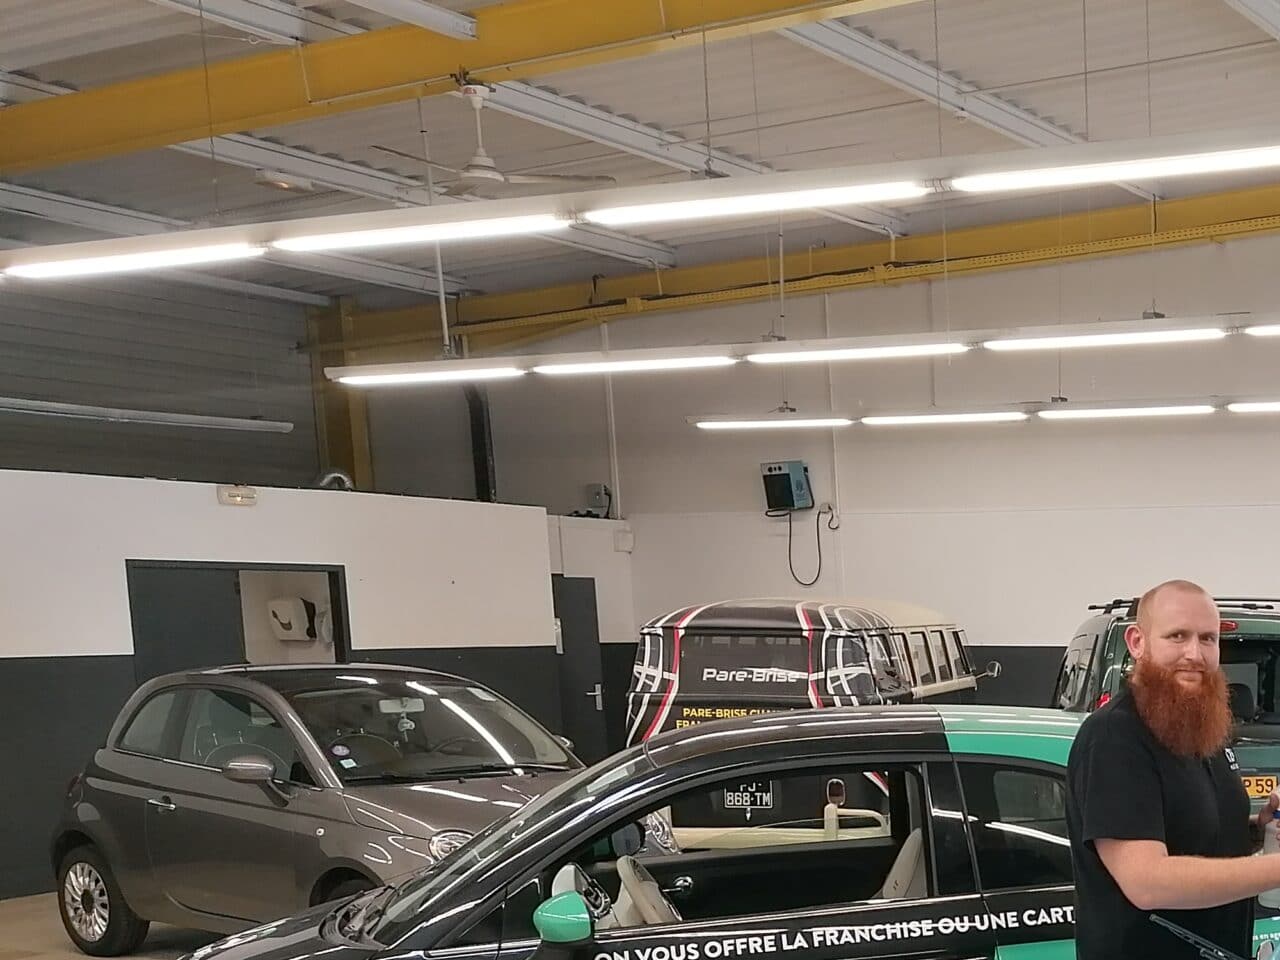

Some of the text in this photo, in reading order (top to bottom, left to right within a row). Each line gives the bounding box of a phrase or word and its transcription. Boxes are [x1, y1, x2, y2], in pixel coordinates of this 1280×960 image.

[702, 667, 798, 683] Pare-Brise
[1256, 778, 1274, 794] 59
[704, 934, 777, 959] OFFRE
[780, 930, 809, 951] LA
[812, 919, 935, 948] FRANCHISE
[938, 915, 970, 934] OU
[974, 910, 1020, 930] UNE
[1022, 905, 1076, 926] CART
